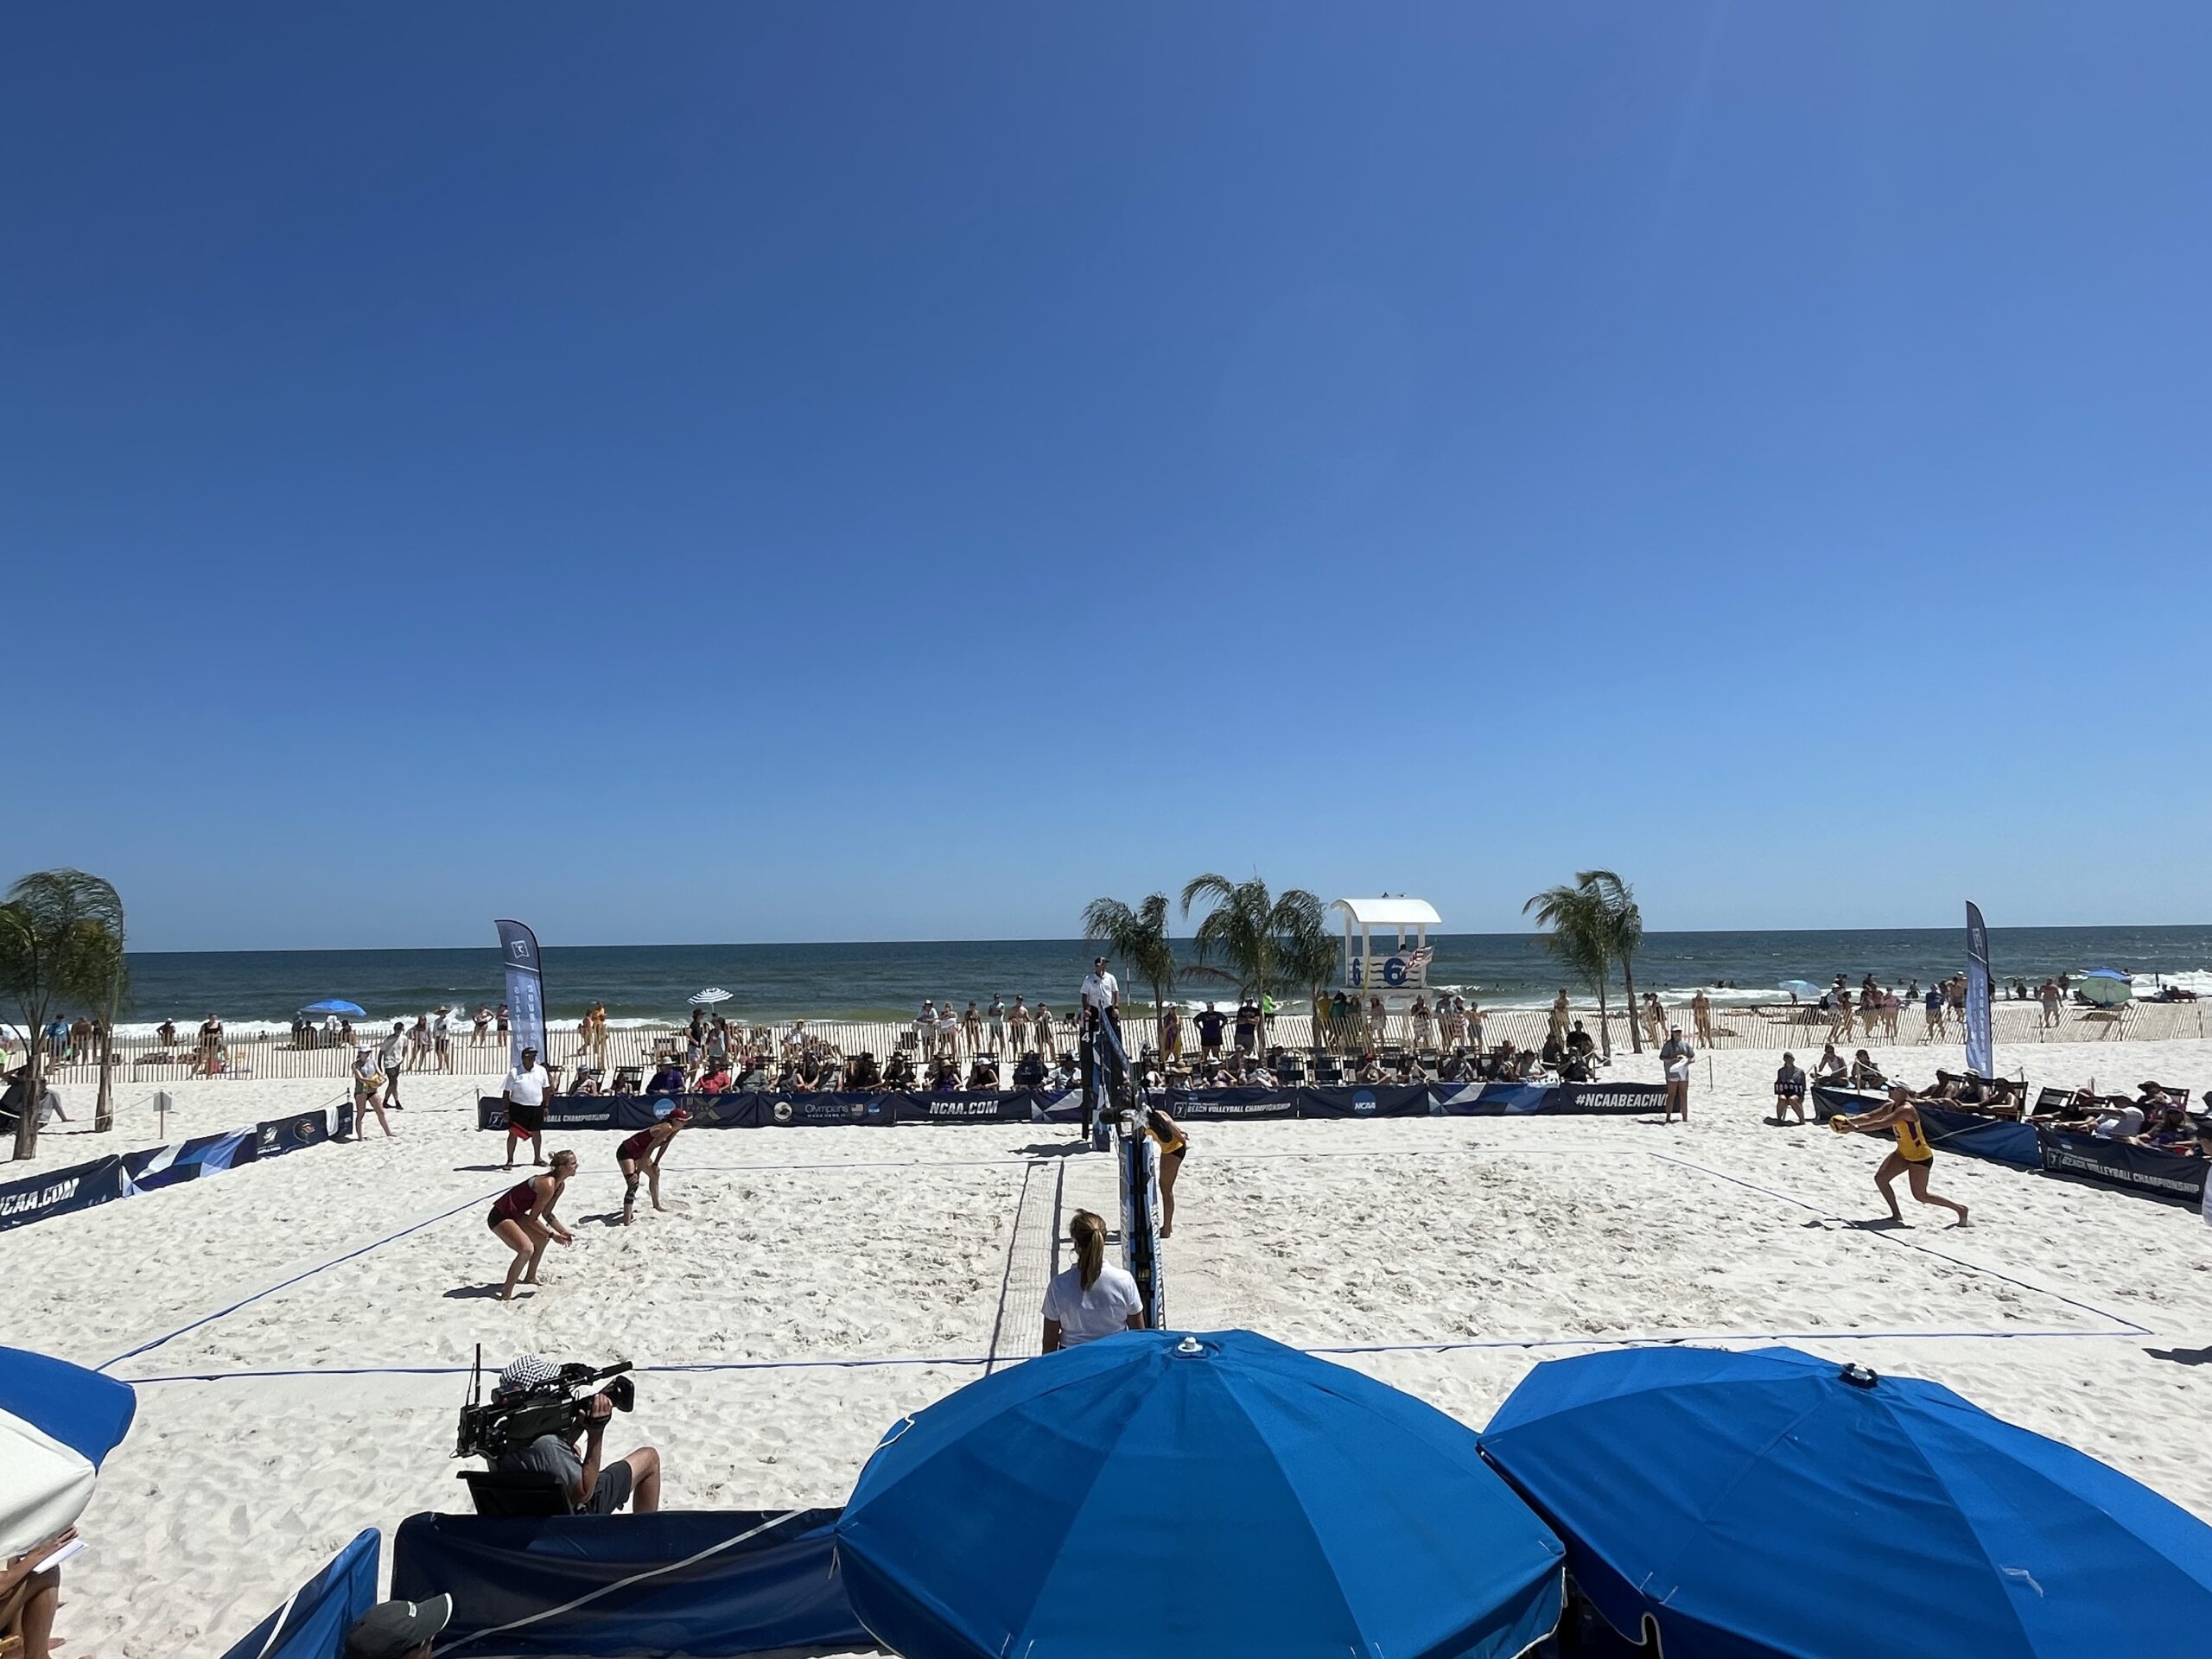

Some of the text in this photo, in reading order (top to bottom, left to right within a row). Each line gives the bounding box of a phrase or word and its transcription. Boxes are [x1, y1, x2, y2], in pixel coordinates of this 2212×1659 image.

[1353, 958, 1361, 985] 6
[1383, 957, 1407, 985] 6
[1081, 1032, 1090, 1043] 4
[1354, 1102, 1376, 1110] NCAA
[1575, 1093, 1669, 1107] #NCAABEACHV
[804, 1104, 849, 1113] Olympians
[929, 1100, 999, 1115] NCAA.COM
[1208, 1104, 1244, 1113] VOLLEYBALL
[1245, 1103, 1291, 1113] CHAMPIONSHIP
[563, 1114, 610, 1122] CHAMPIONSHIP
[2087, 1162, 2133, 1181] VOLLEYBALL
[2133, 1173, 2200, 1194] CHAMPIONSHIP
